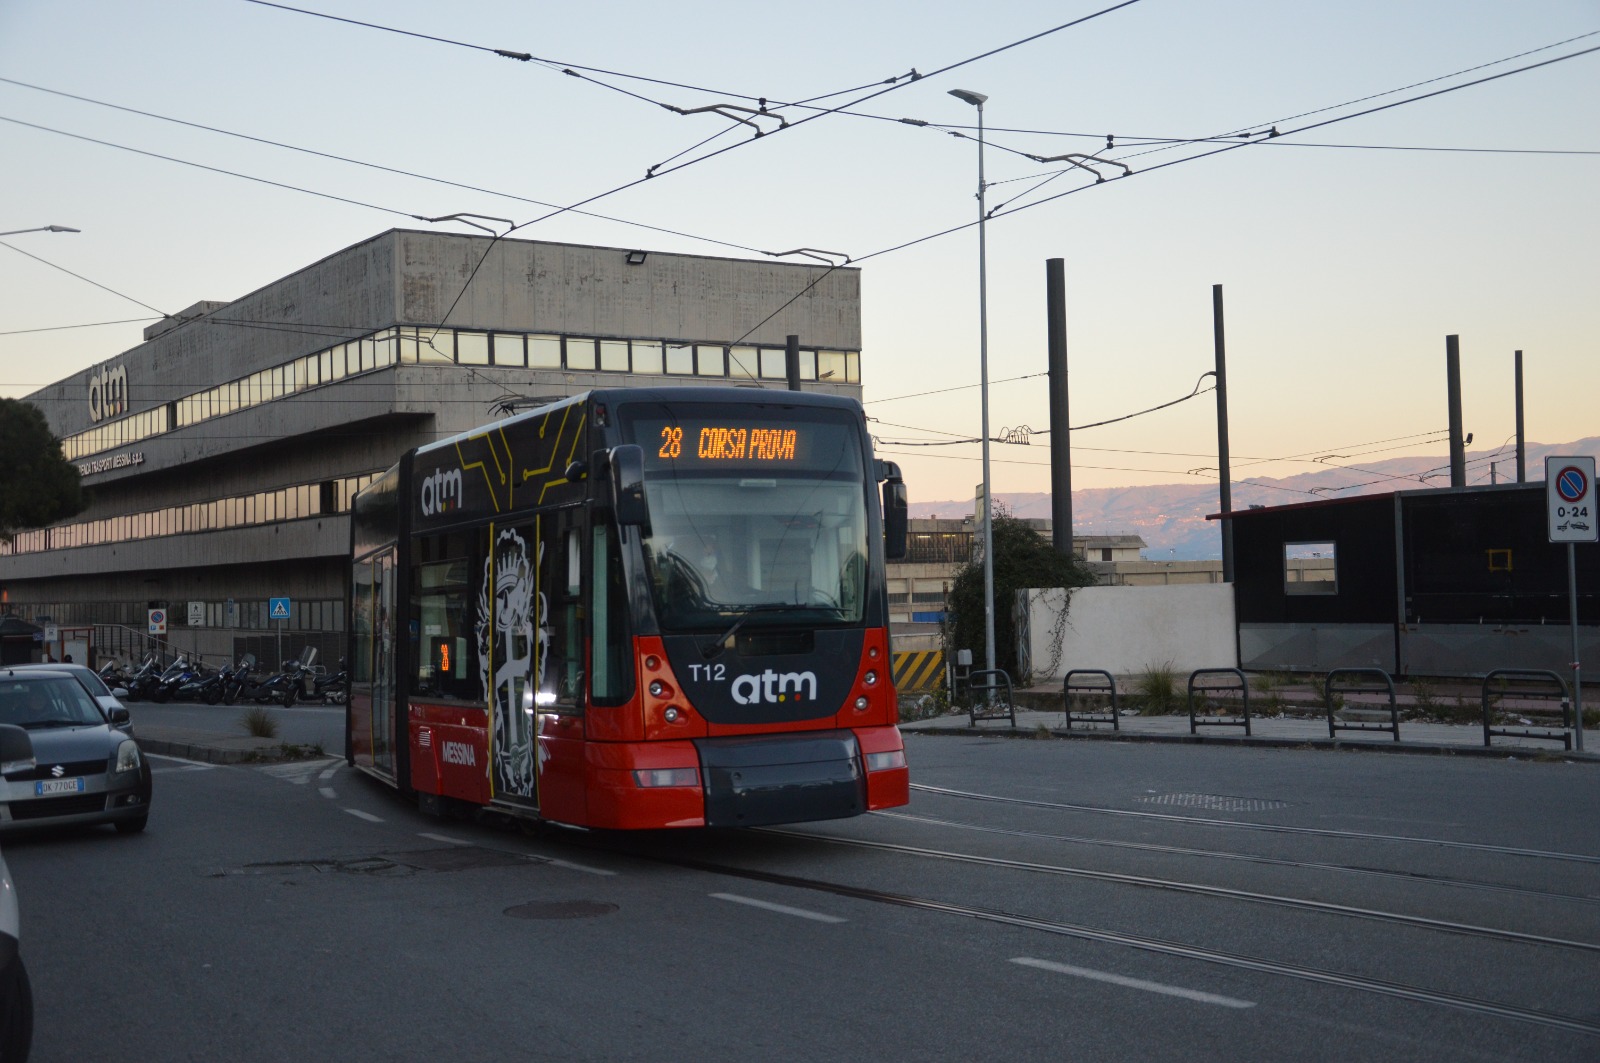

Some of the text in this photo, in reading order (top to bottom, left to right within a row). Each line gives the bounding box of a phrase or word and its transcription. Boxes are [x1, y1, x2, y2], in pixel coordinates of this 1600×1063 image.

[89, 364, 128, 422] atm
[113, 452, 131, 468] MESSINA
[659, 427, 797, 460] 28 CORSA PROVA
[421, 467, 462, 516] atm
[688, 664, 726, 681] T12
[731, 669, 817, 705] atm
[442, 740, 476, 767] MESSINA
